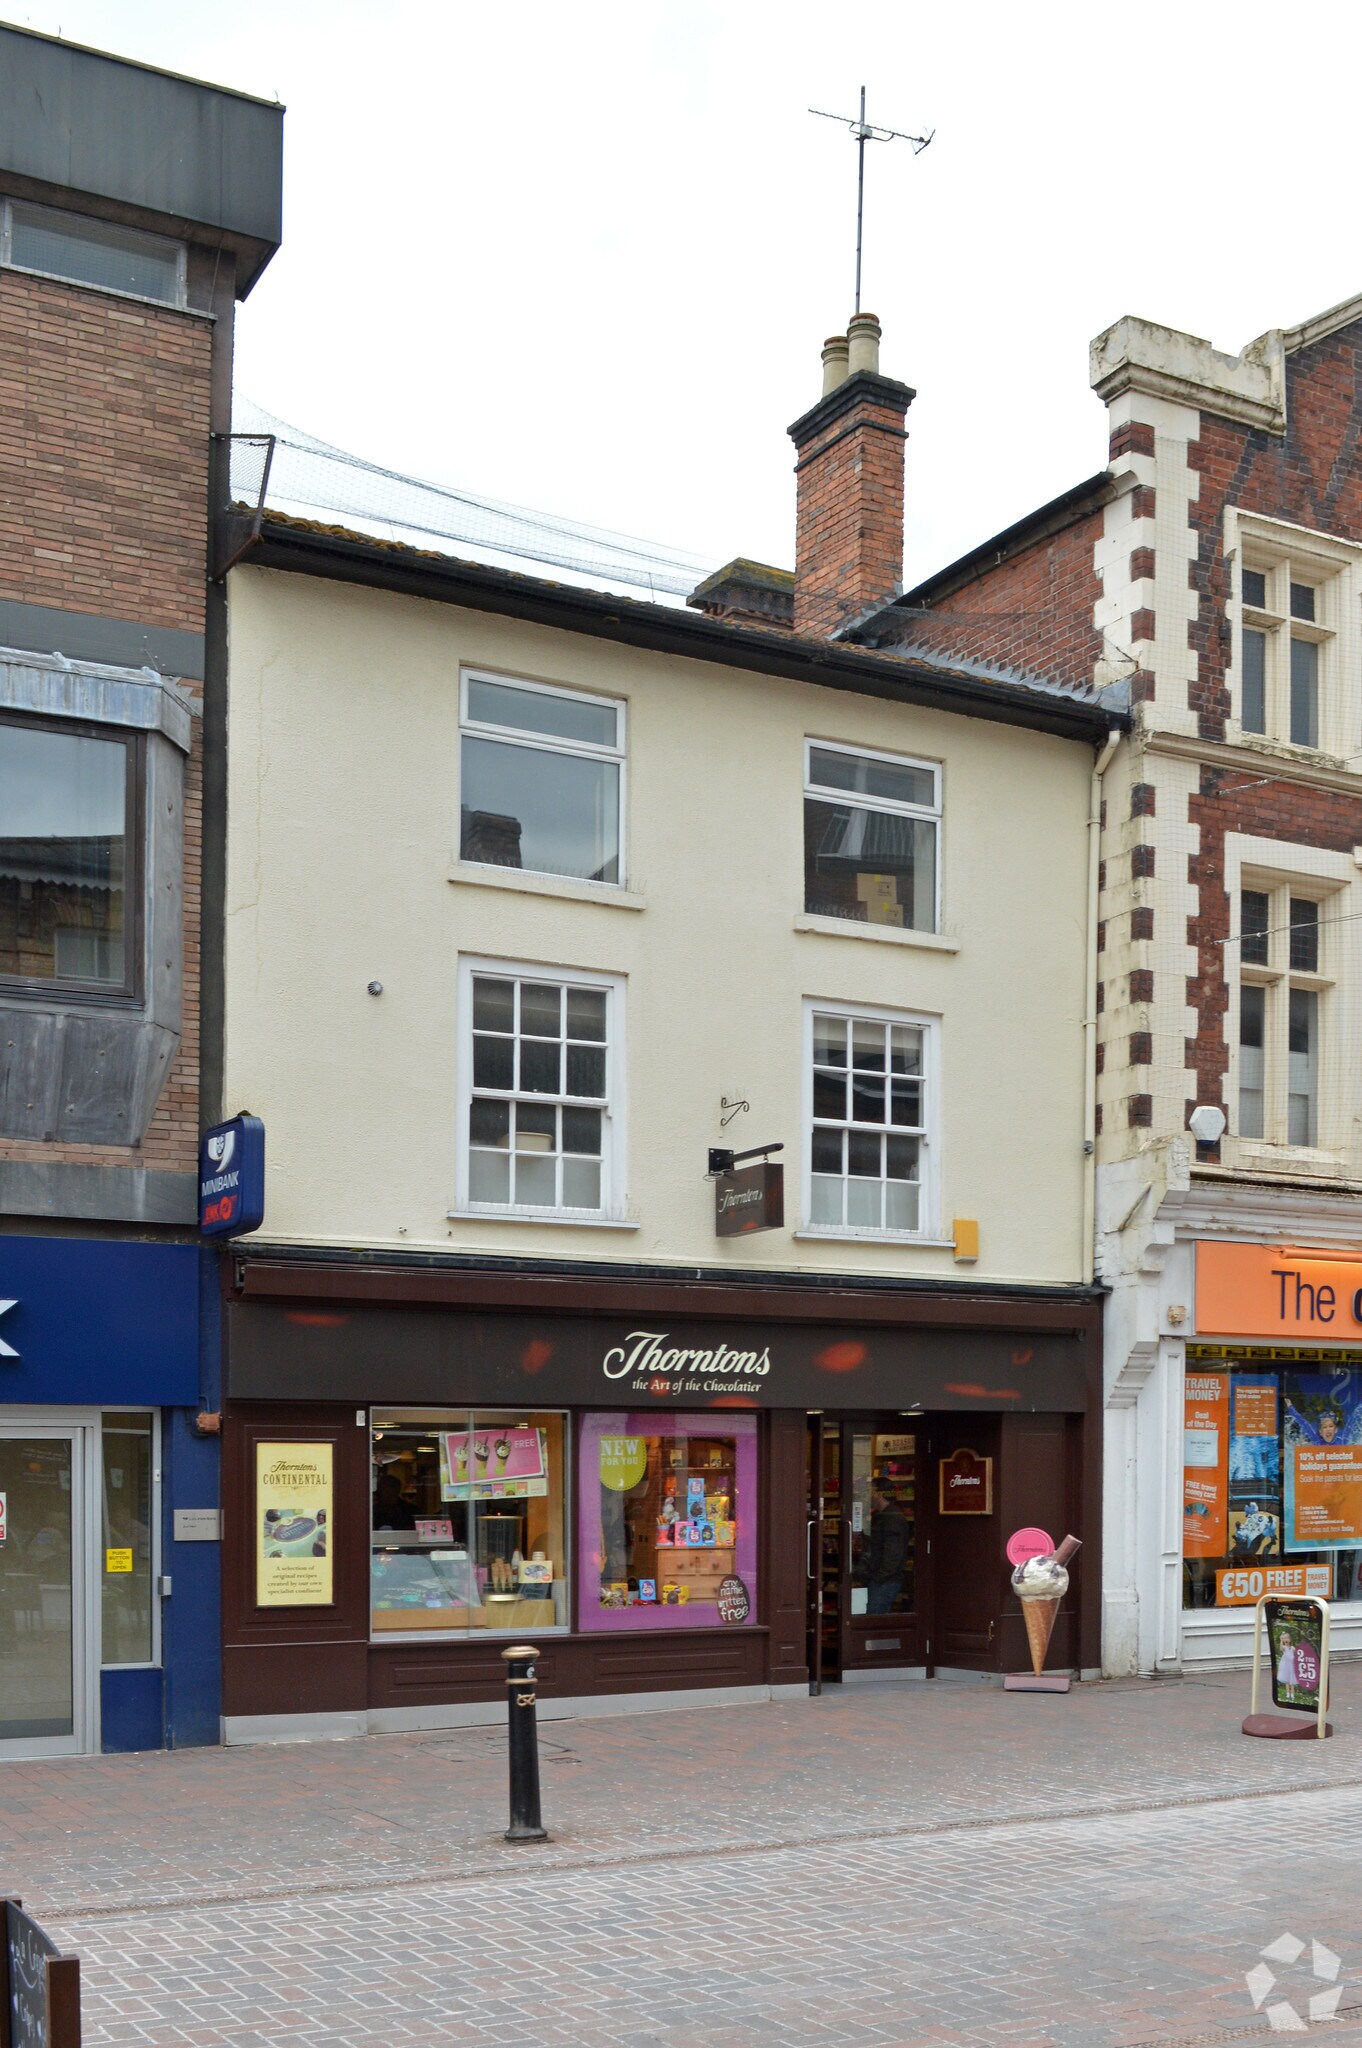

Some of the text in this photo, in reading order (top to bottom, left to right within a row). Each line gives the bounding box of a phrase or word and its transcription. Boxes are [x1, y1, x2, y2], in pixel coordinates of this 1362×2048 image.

[202, 1171, 239, 1197] MINIBANK
[1271, 1270, 1335, 1323] The
[603, 1331, 771, 1379] Thorntons
[632, 1377, 762, 1395] the Art of the Chocolatier
[1185, 1377, 1222, 1390] TRAVEL
[1185, 1389, 1221, 1401] MONEY
[1195, 1411, 1209, 1419] Deal
[1186, 1420, 1217, 1430] of the Day
[514, 1438, 536, 1449] FREE
[600, 1439, 639, 1457] NEW
[600, 1456, 639, 1466] FOR YOU
[1299, 1452, 1353, 1461] 10% off selected
[271, 1460, 318, 1473] Thorntons
[1300, 1462, 1328, 1472] holidays
[263, 1473, 328, 1485] CONTINENTAL
[1185, 1480, 1201, 1490] FREE
[1307, 1573, 1328, 1581] TRAVEL
[1221, 1569, 1304, 1598] €50 FREE
[1307, 1581, 1327, 1589] MONEY
[720, 1586, 744, 1597] name
[717, 1596, 748, 1608] written
[721, 1605, 749, 1621] free
[1297, 1649, 1305, 1662] 2
[1298, 1664, 1317, 1680] £5
